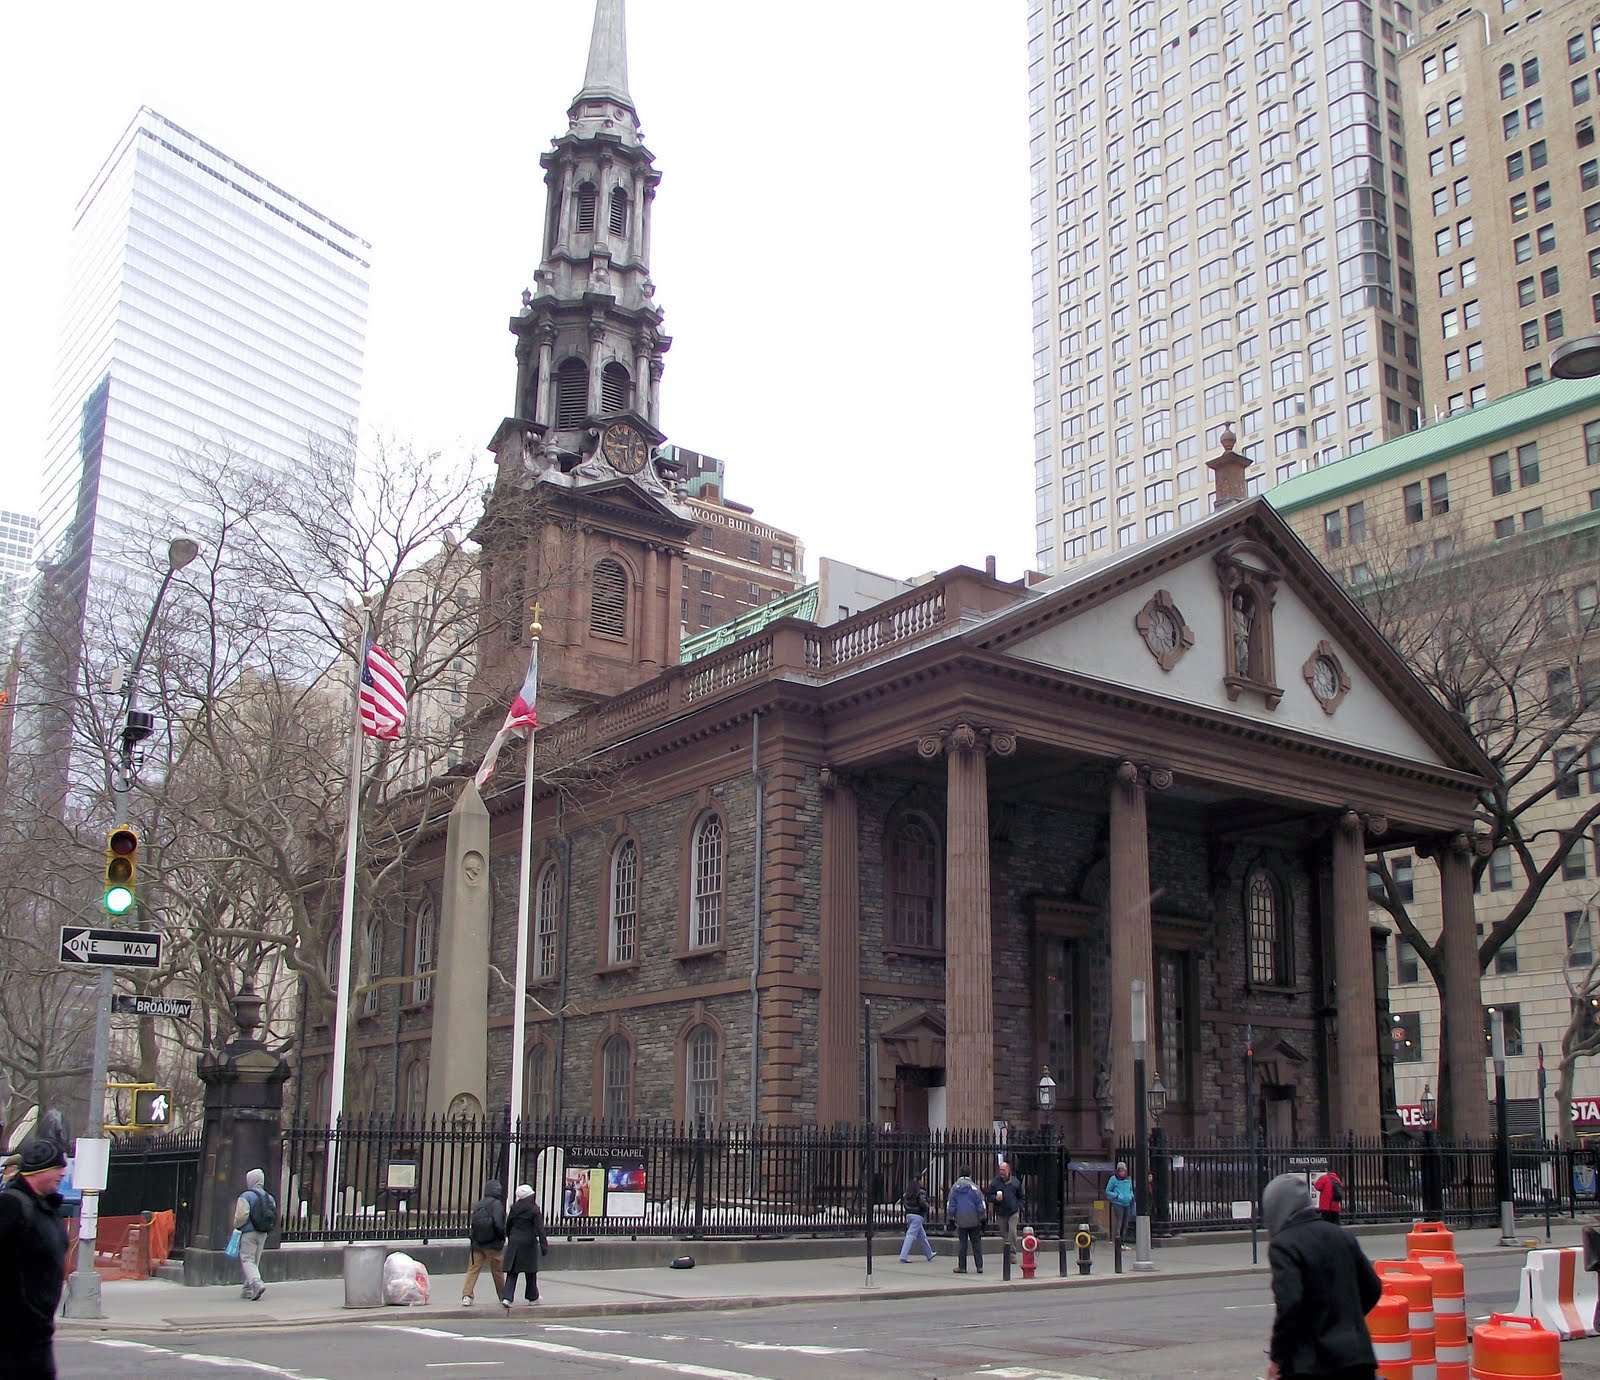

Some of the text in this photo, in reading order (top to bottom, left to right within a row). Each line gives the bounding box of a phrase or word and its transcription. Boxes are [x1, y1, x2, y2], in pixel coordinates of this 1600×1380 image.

[728, 517, 779, 541] BUILDING
[70, 939, 151, 955] ONE WAY
[136, 1000, 191, 1015] BROADWAY
[571, 1147, 644, 1157] ST. PAUL'S CHAPEL
